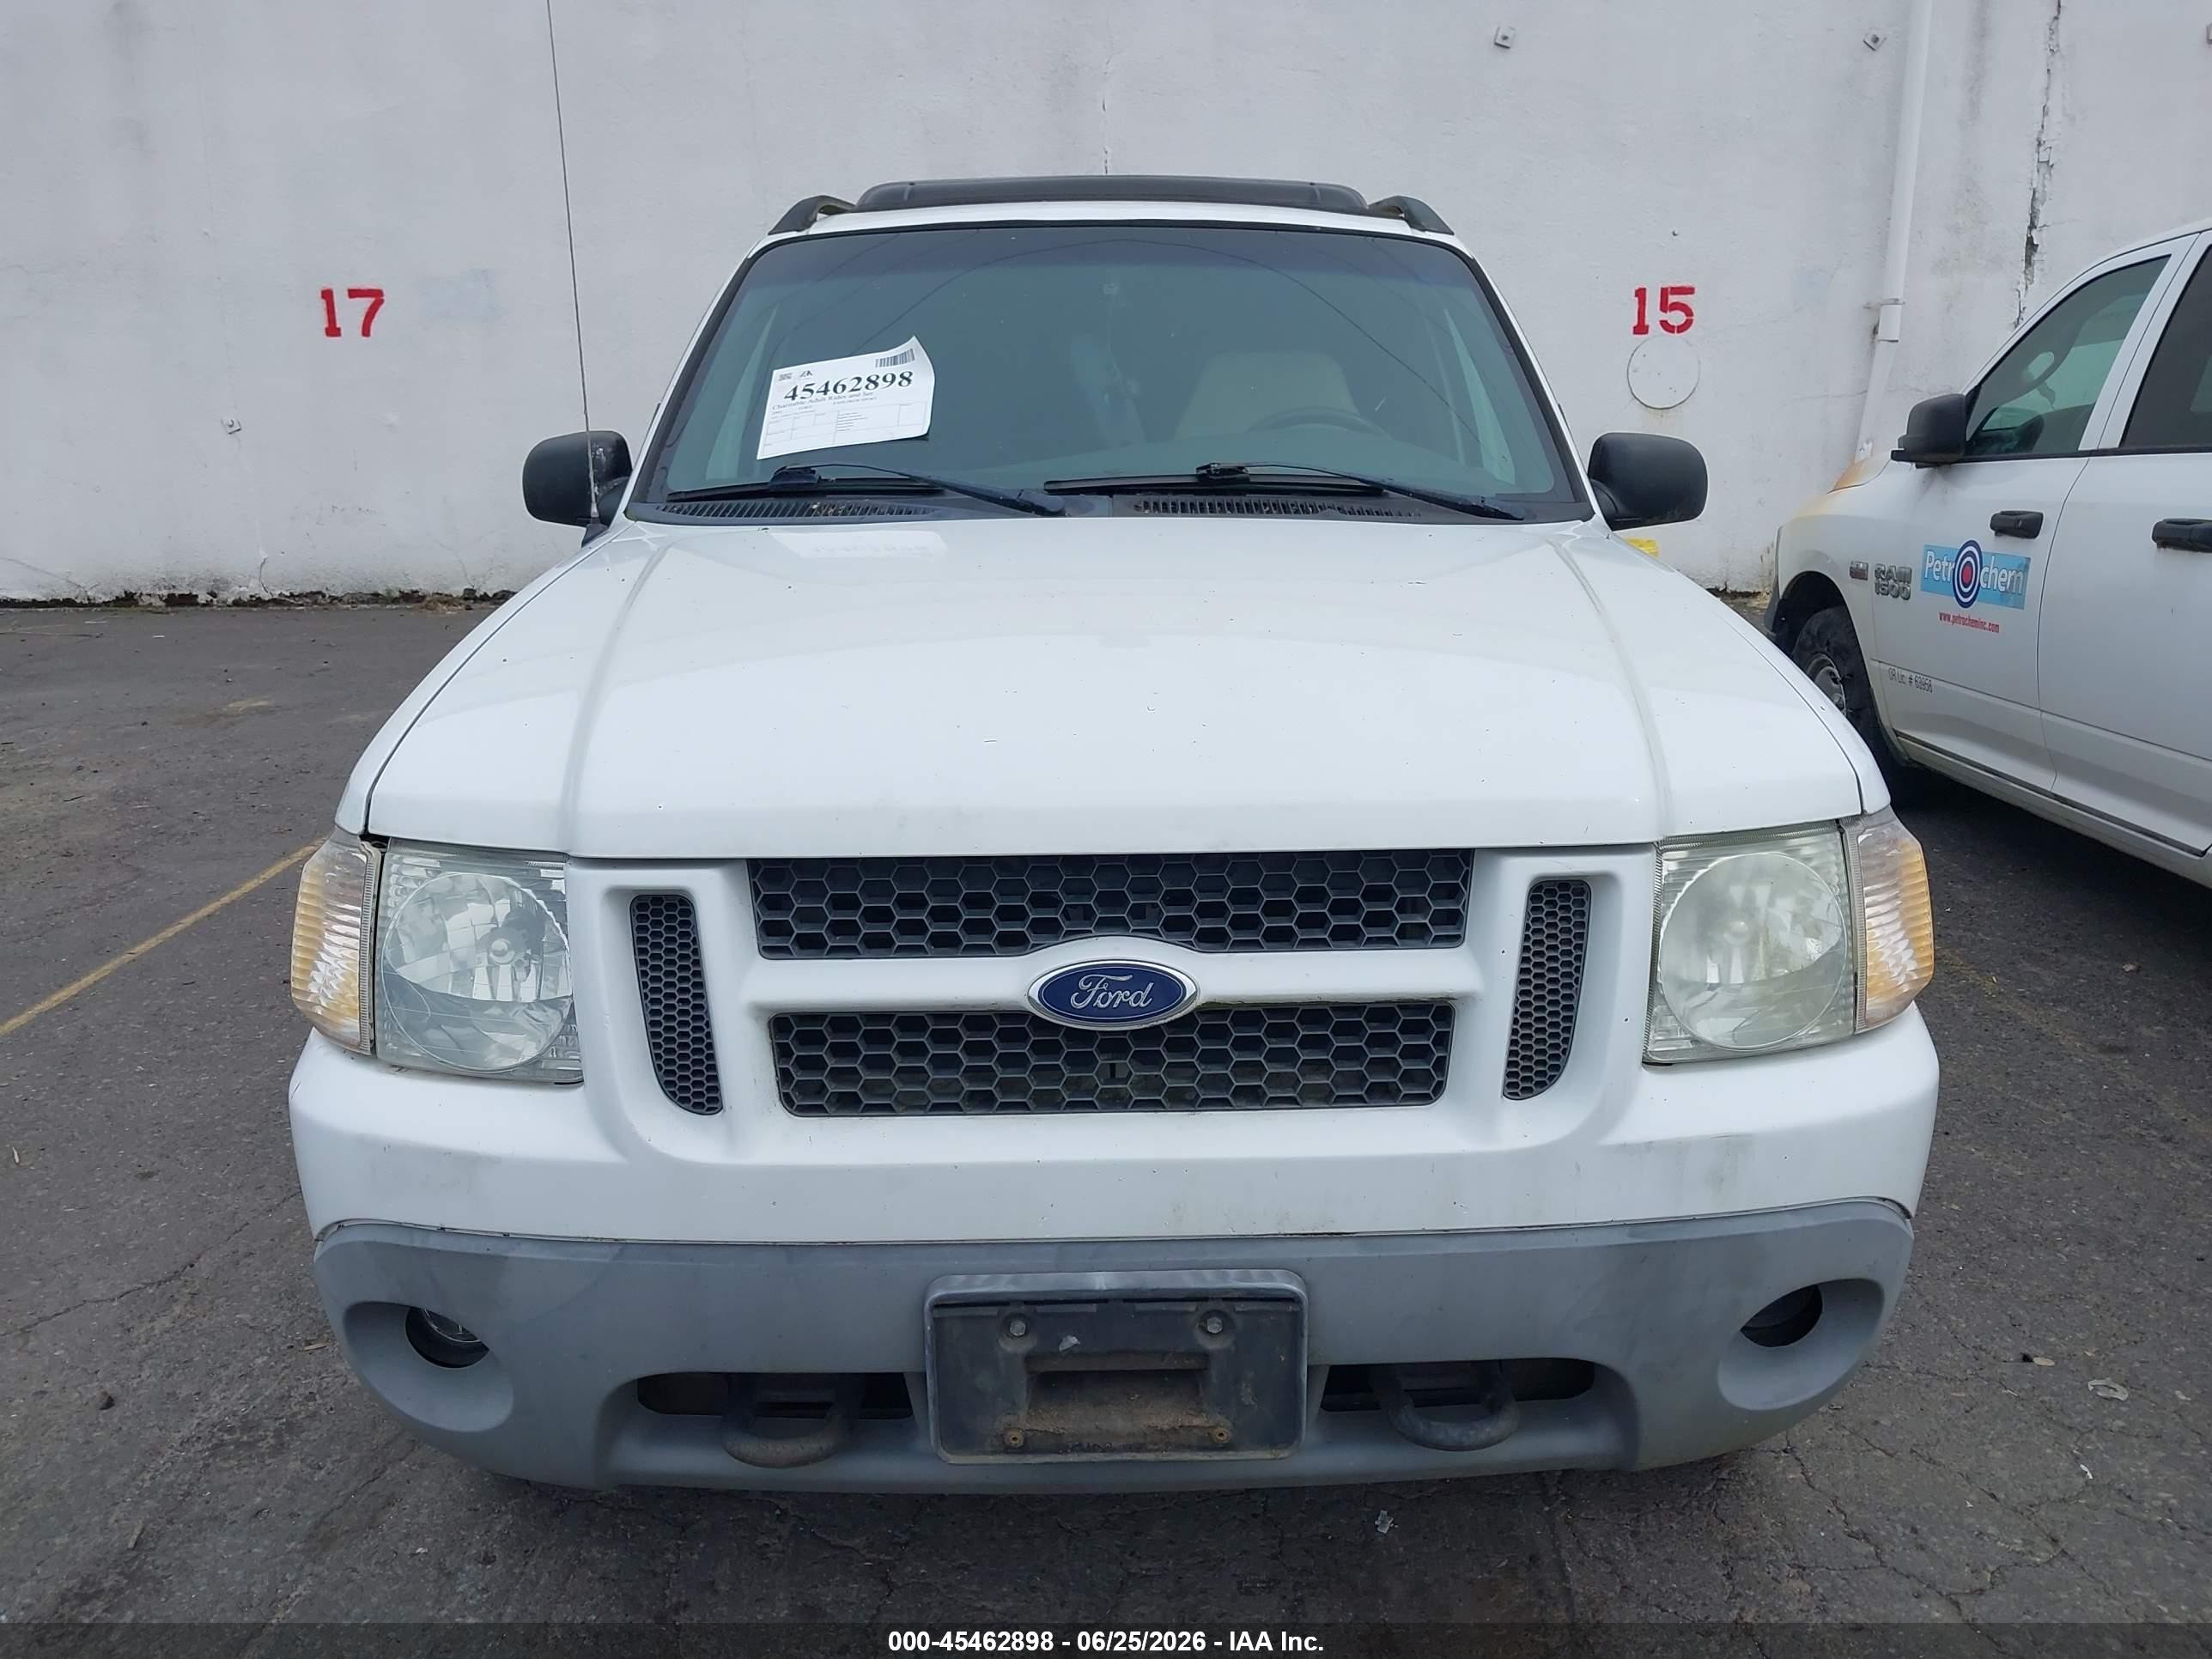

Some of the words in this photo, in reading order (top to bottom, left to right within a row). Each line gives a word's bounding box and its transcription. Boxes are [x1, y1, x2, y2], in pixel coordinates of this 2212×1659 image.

[320, 288, 386, 337] 17
[1632, 286, 1696, 336] 15
[783, 370, 914, 401] 45462898
[1875, 579, 1911, 600] 1500
[1070, 974, 1155, 1009] Ford
